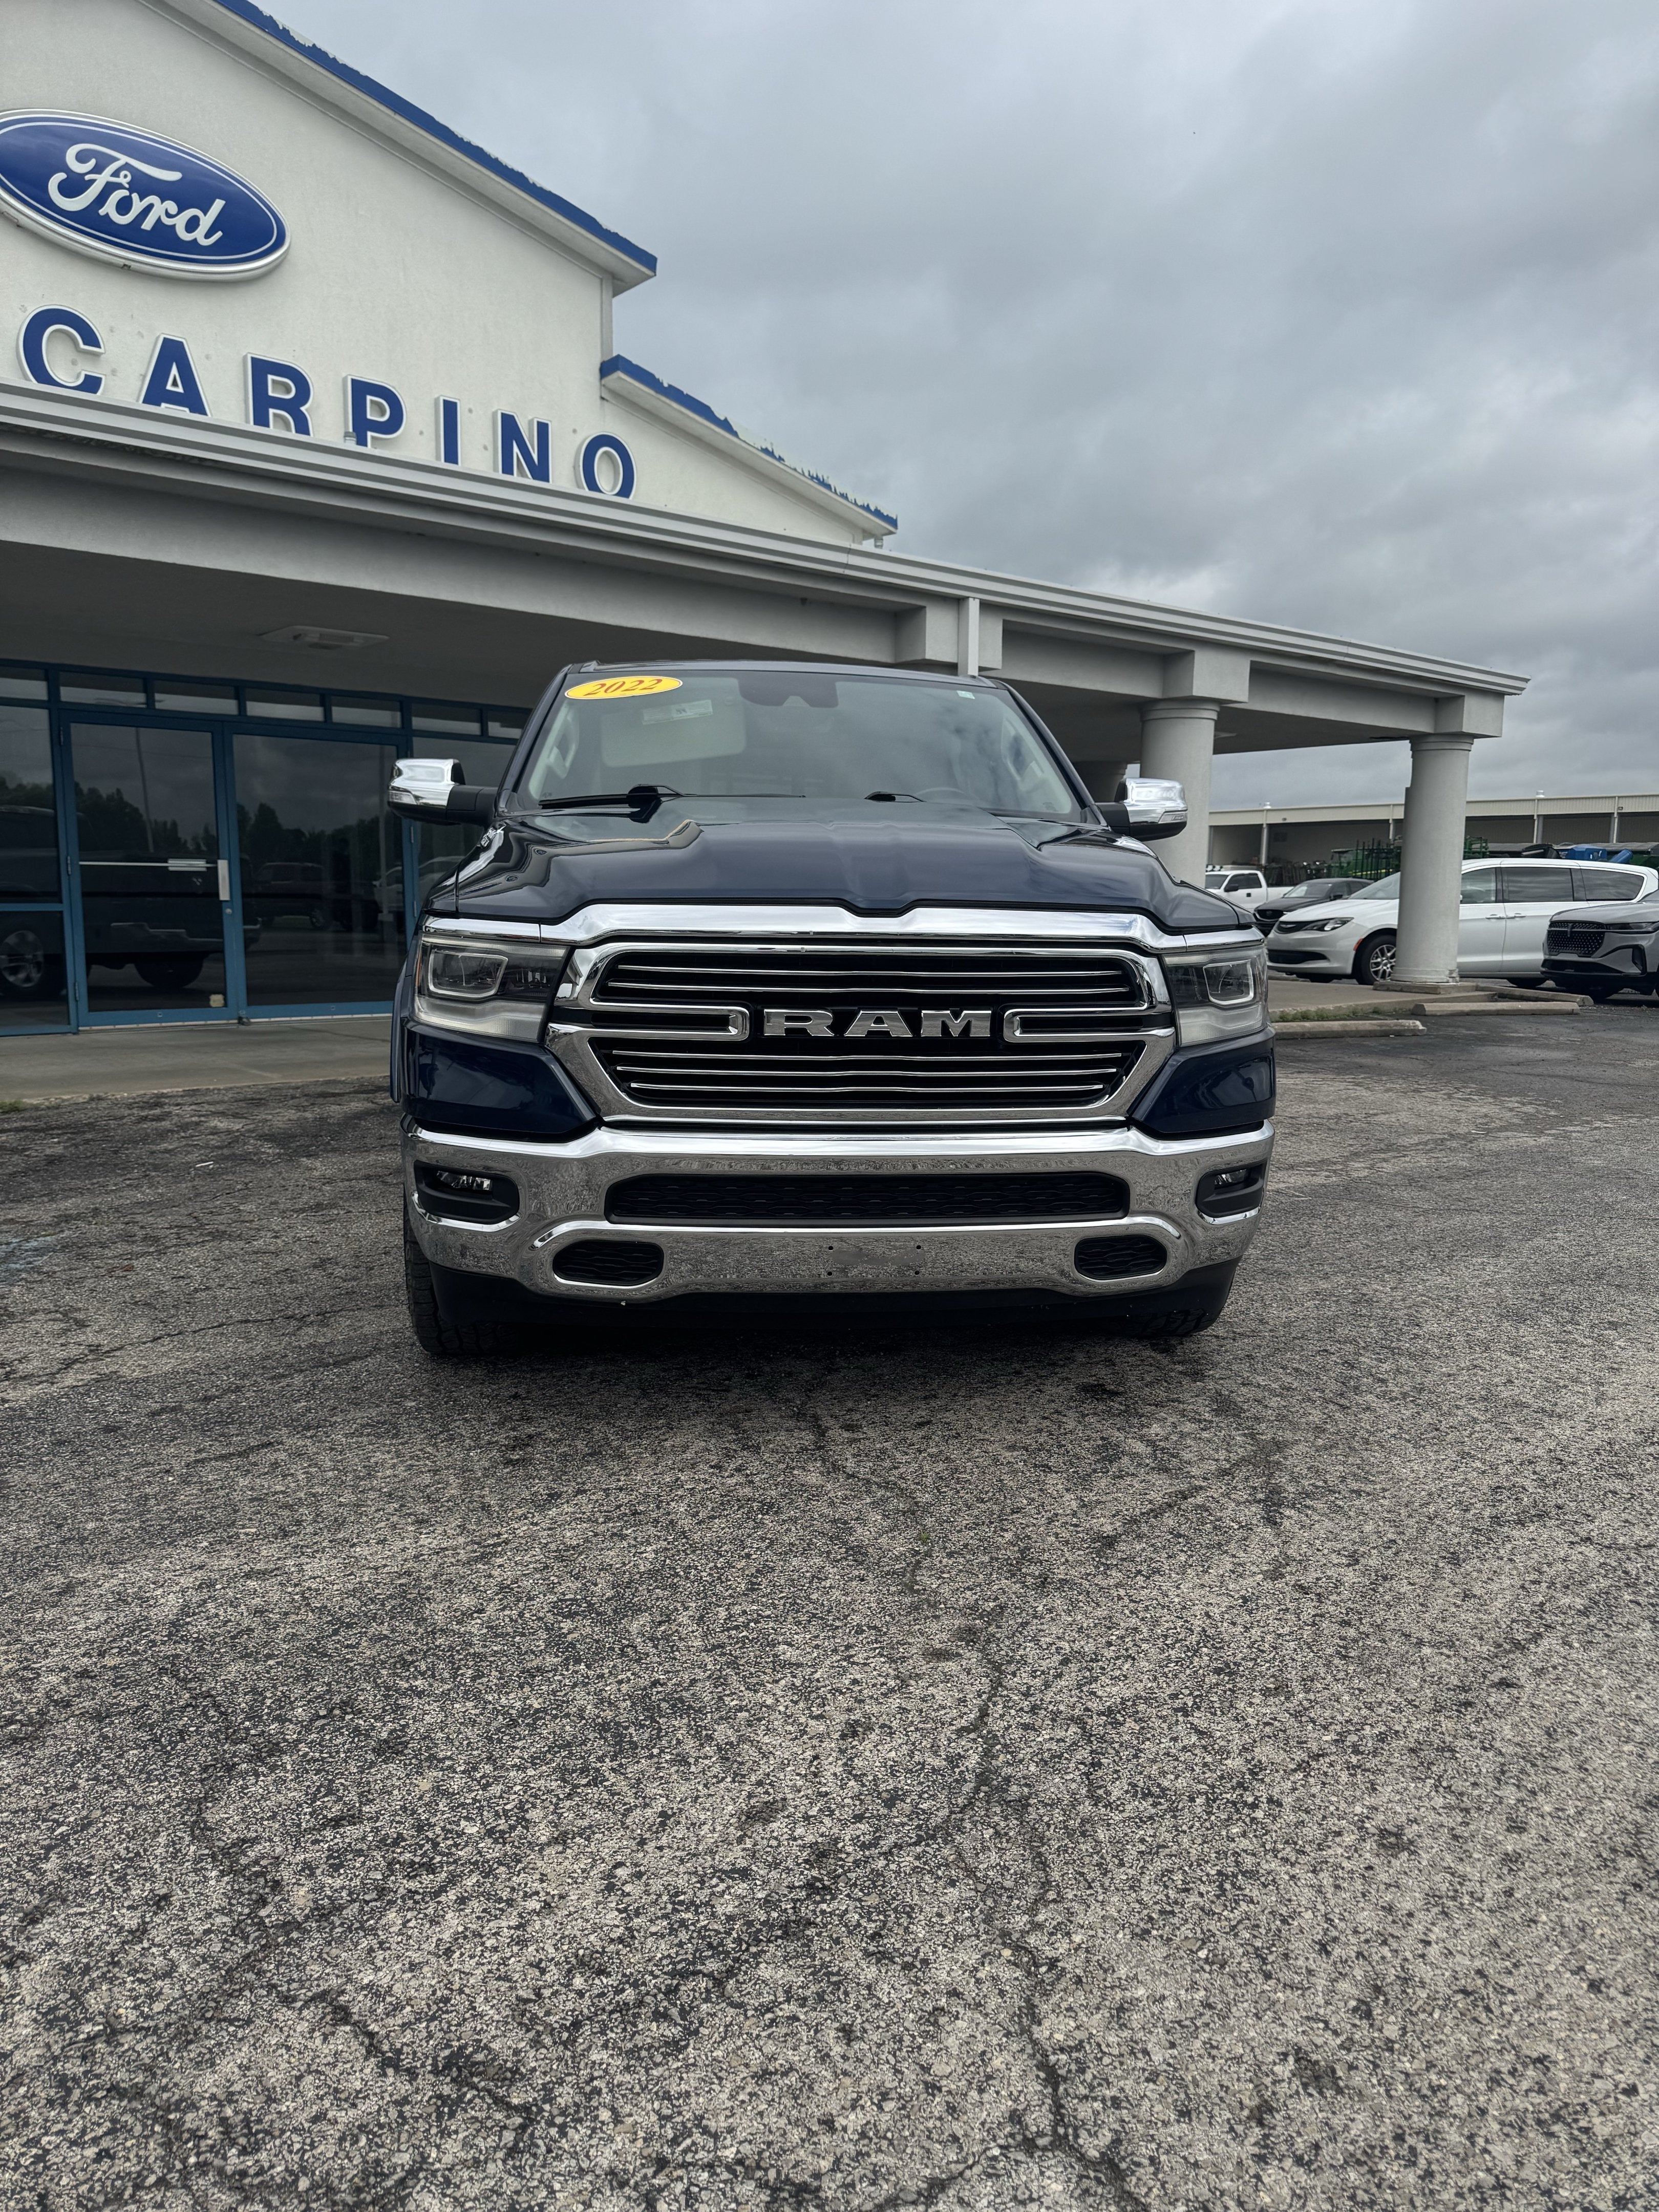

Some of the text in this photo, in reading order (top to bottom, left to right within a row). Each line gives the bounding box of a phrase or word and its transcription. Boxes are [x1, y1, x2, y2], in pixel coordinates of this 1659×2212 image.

[48, 143, 226, 246] Ford
[17, 304, 637, 500] CARPINO
[583, 678, 663, 696] 2022
[763, 1008, 992, 1037] RAM
